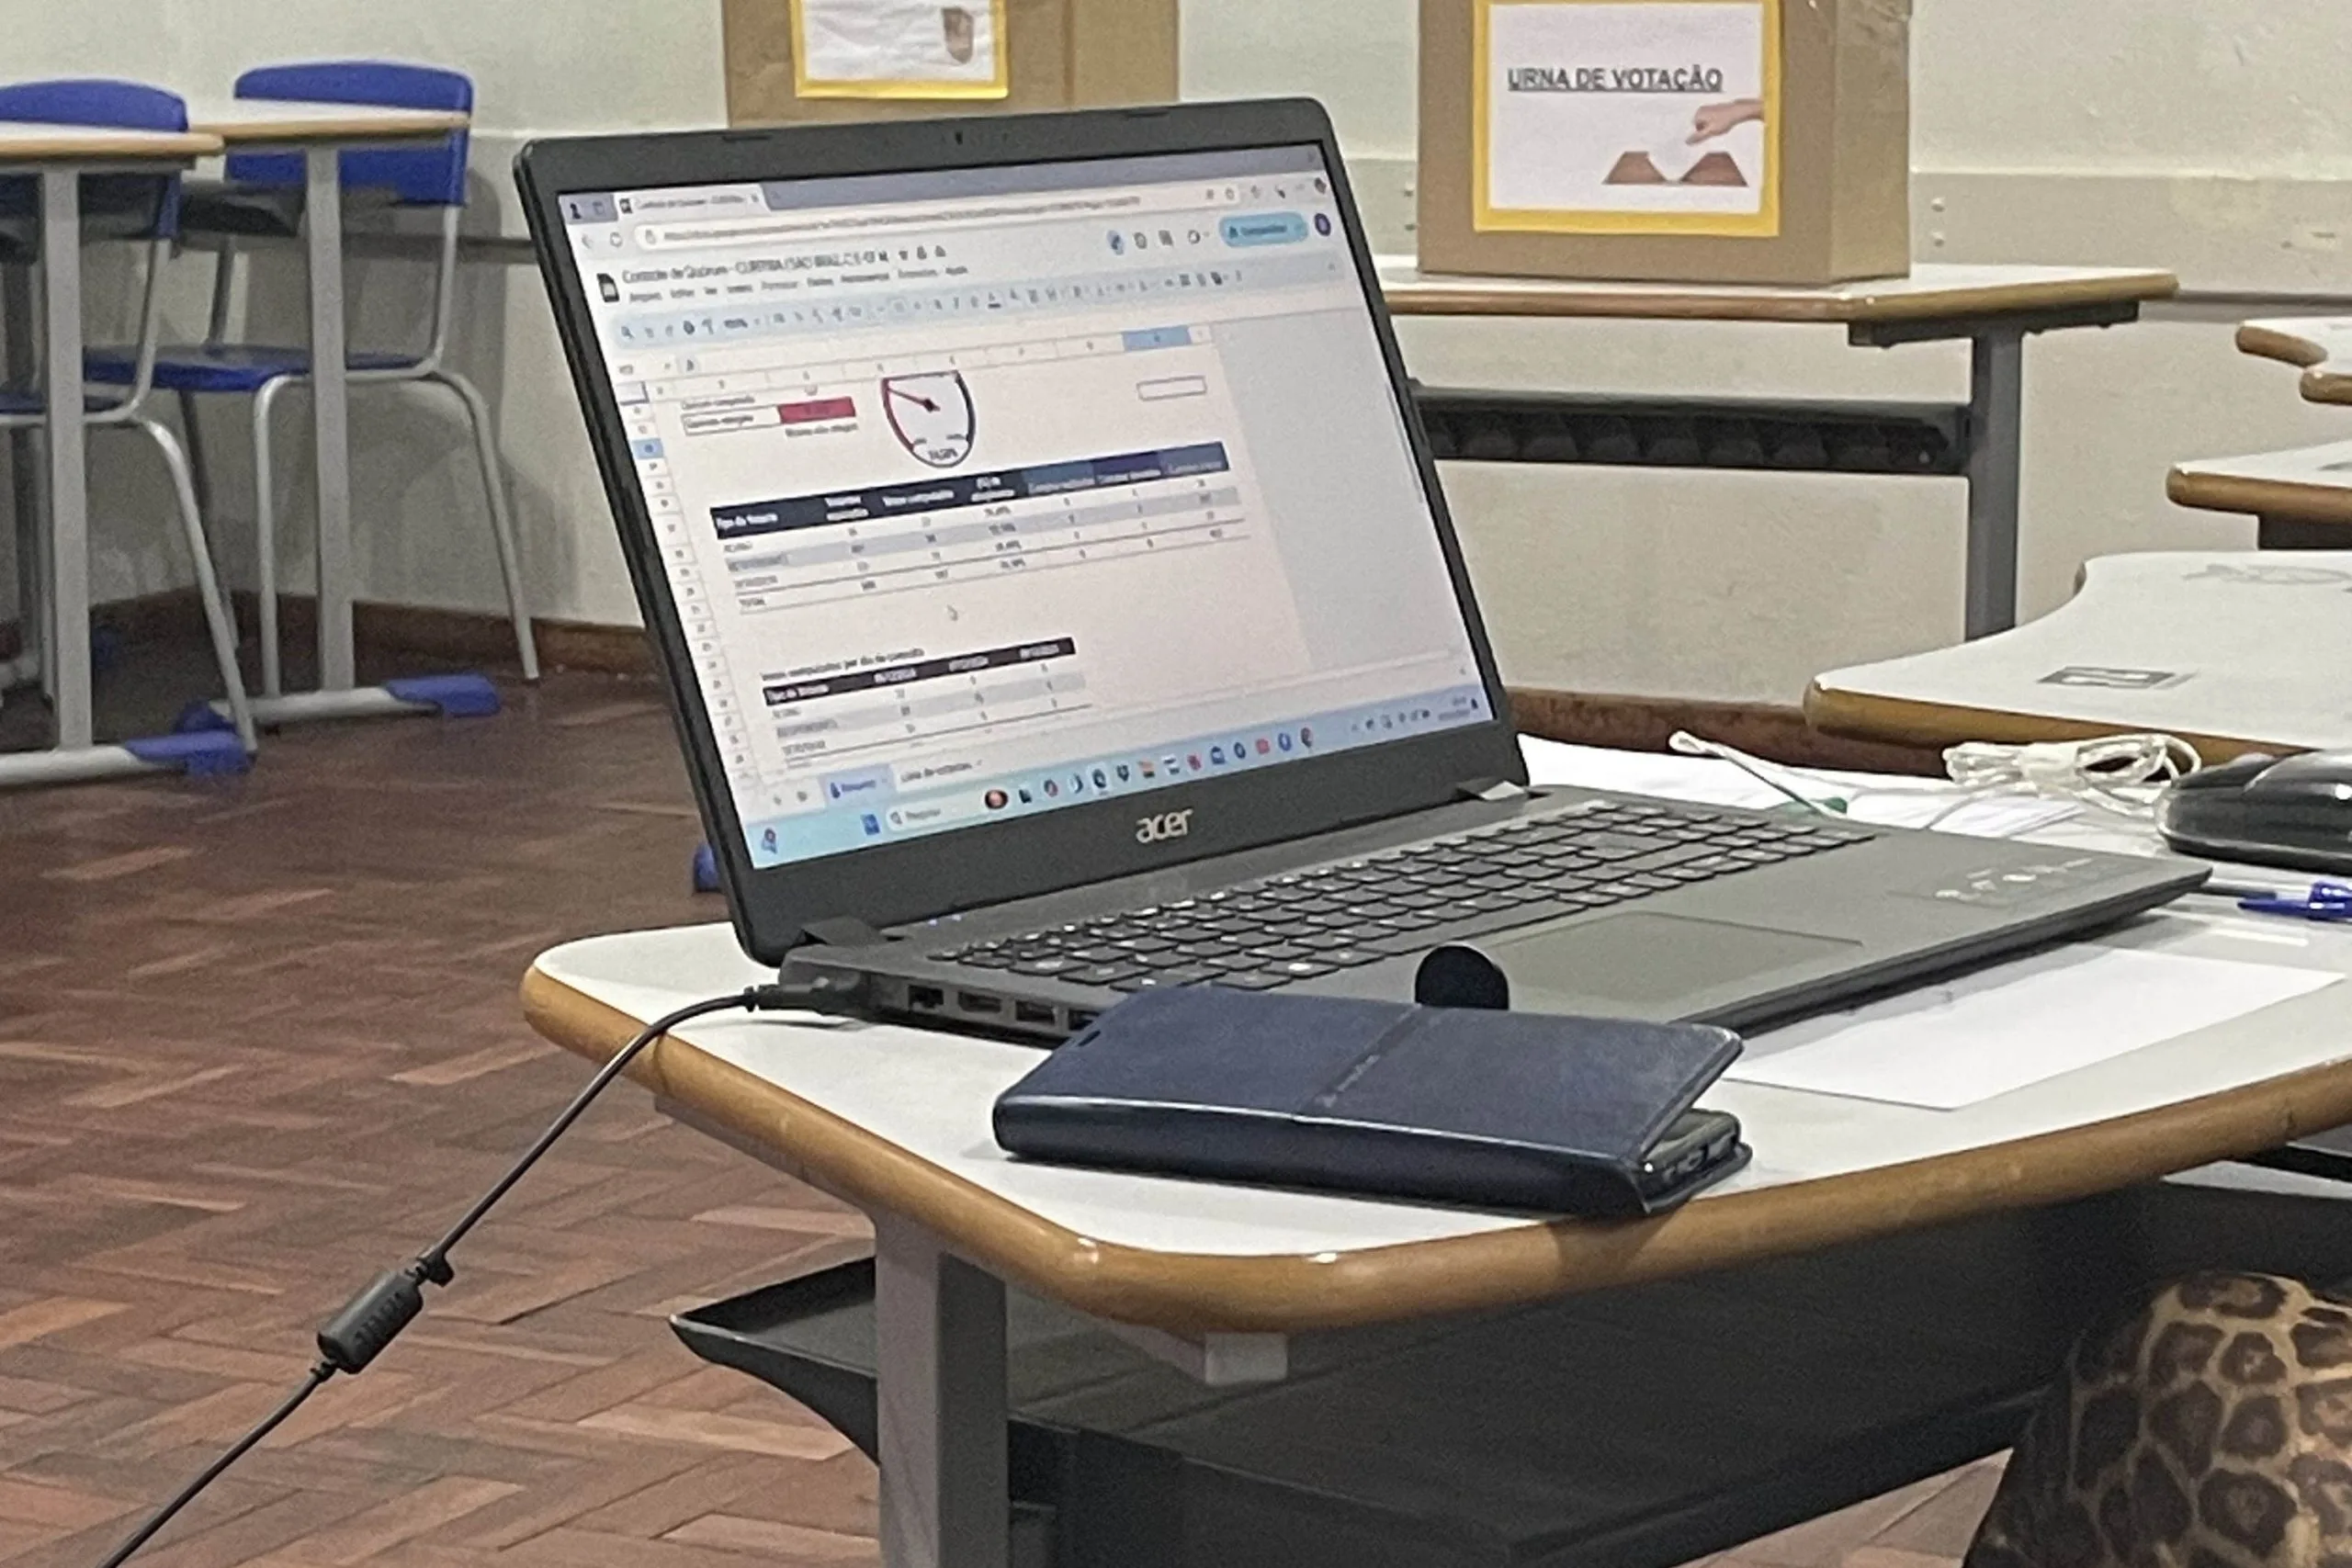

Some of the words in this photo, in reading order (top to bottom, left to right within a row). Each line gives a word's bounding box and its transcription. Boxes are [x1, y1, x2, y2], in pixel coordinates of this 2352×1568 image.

[1508, 68, 1569, 91] URNA
[1576, 68, 1605, 91] DE
[1611, 64, 1724, 91] VOTAÇÃO
[1136, 808, 1193, 843] acer
